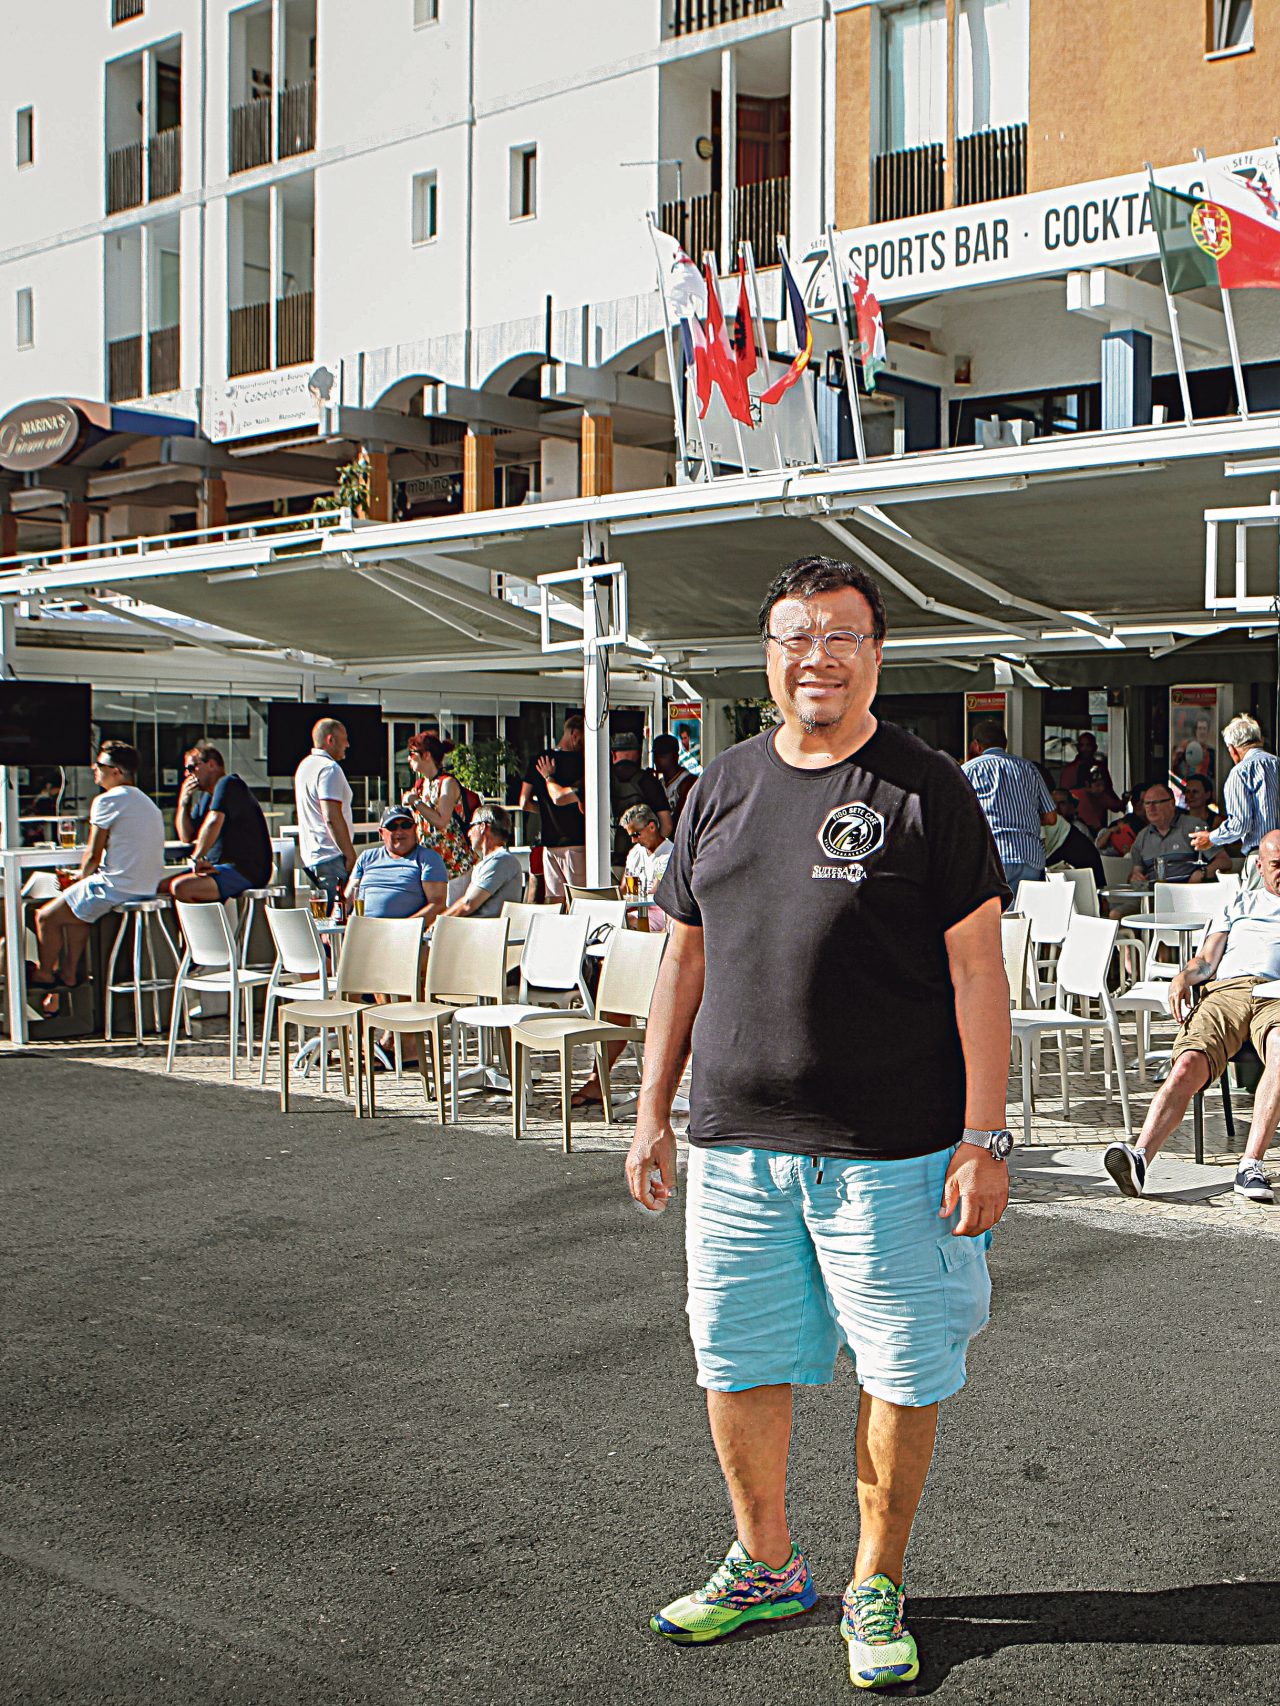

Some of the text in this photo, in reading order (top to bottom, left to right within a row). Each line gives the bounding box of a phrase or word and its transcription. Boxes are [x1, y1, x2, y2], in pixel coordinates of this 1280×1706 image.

[849, 218, 1009, 281] SPORTS BAR
[848, 807, 865, 815] SETE
